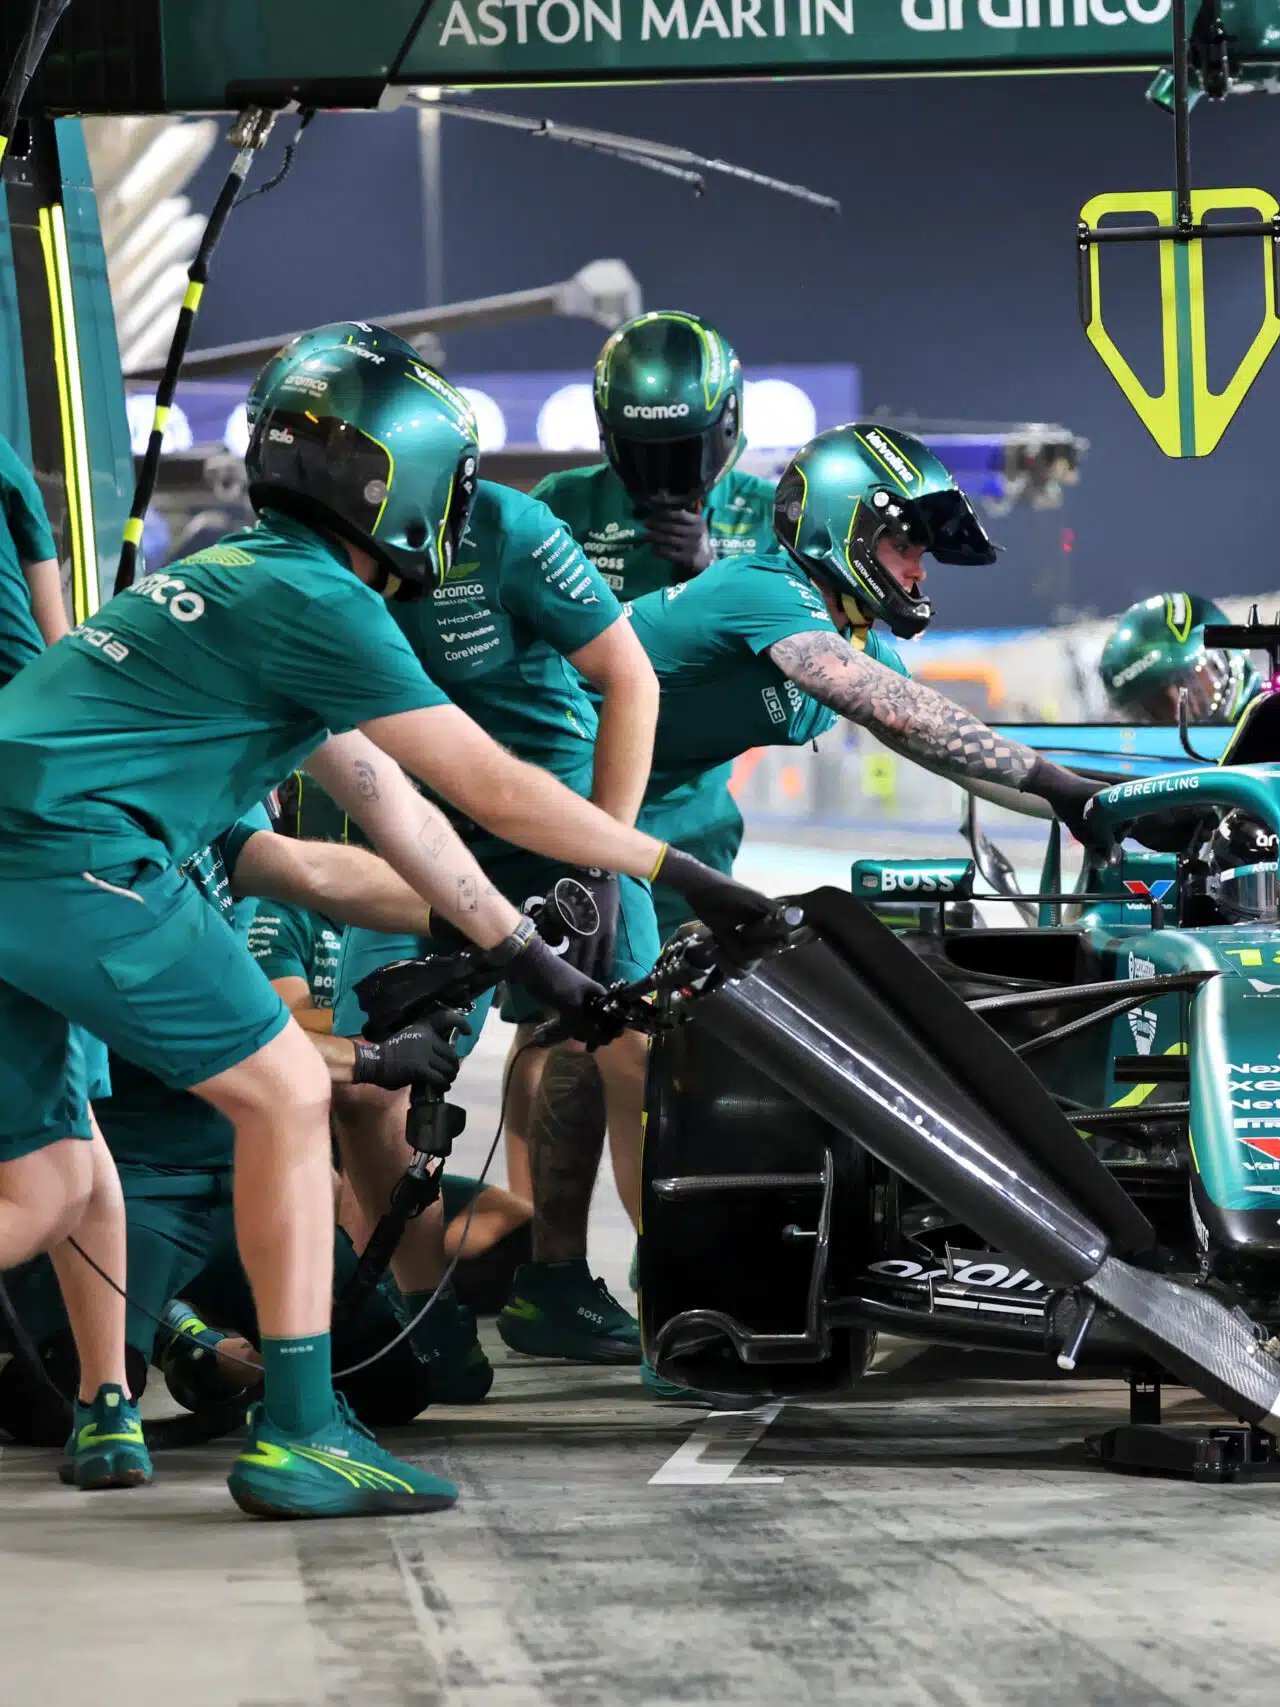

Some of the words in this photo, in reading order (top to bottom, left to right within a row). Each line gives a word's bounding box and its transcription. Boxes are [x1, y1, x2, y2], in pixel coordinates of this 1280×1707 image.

[439, 0, 622, 46] ASTON
[640, 0, 854, 41] MARTIN
[623, 403, 690, 420] aramco
[865, 431, 914, 483] Valvoline
[853, 559, 870, 580] ASTON
[866, 576, 886, 600] MARTIN
[433, 584, 484, 599] aramco
[447, 609, 491, 625] Honda
[457, 625, 496, 641] Valvoline
[445, 638, 500, 661] CoreWeave
[762, 686, 786, 724] JCB
[783, 680, 803, 713] BOSS
[1124, 776, 1199, 797] BREITLING
[1251, 861, 1278, 873] ASTO
[882, 867, 955, 892] BOSS
[577, 1306, 604, 1325] BOSS
